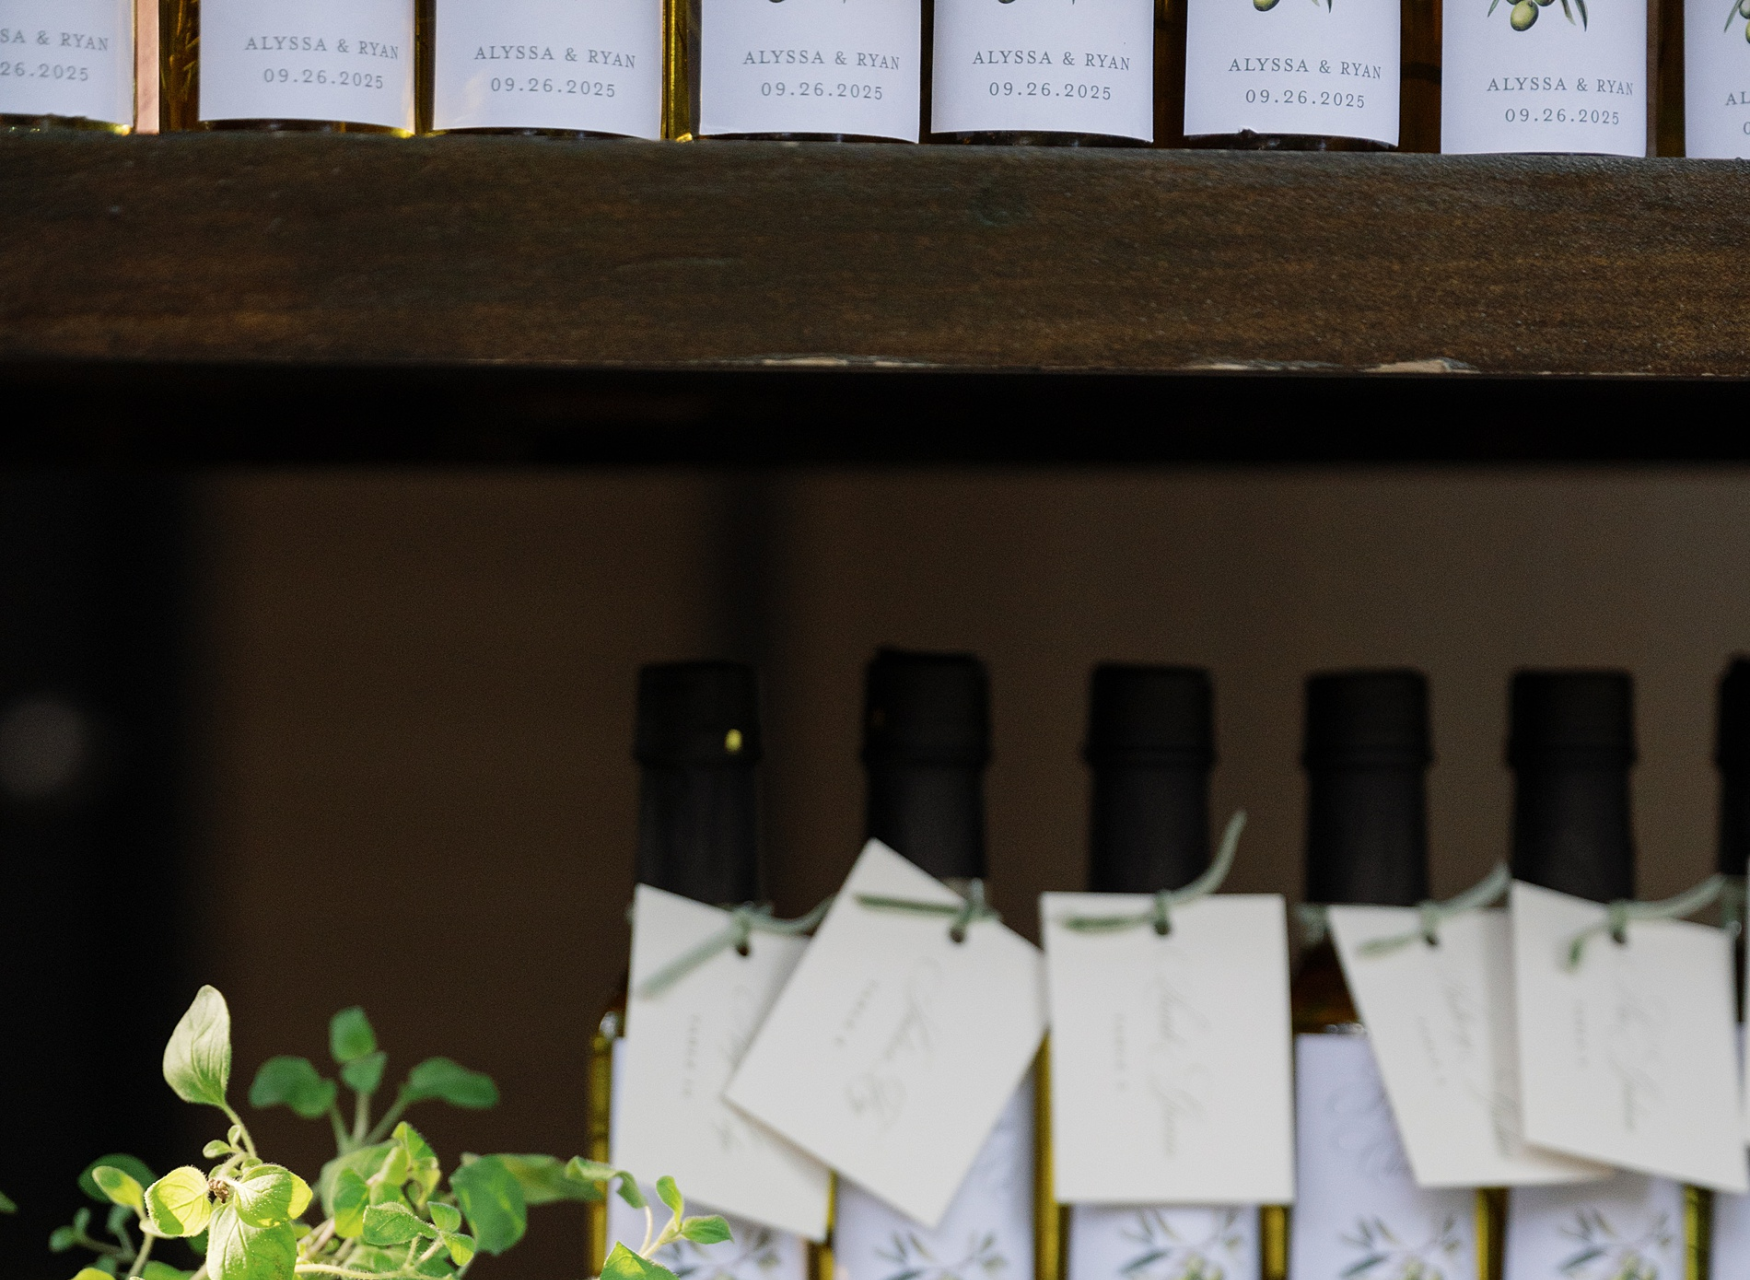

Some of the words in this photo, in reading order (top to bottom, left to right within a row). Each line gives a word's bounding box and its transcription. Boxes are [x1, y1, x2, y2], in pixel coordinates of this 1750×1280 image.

[36, 30, 49, 45] &
[60, 32, 108, 51] RYAN
[245, 36, 327, 51] ALYSSA
[337, 39, 349, 53] &
[358, 40, 398, 59] RYAN
[474, 46, 554, 60] ALYSSA
[565, 47, 577, 62] &
[588, 49, 635, 68] RYAN
[743, 50, 824, 65] ALYSSA
[834, 51, 847, 65] &
[857, 52, 899, 69] RYAN
[973, 50, 1052, 64] ALYSSA
[1062, 52, 1075, 66] &
[1085, 53, 1129, 70] RYAN
[263, 68, 383, 89] 09.26.2025
[1229, 58, 1309, 72] ALYSSA
[1319, 60, 1330, 74] &
[1340, 61, 1381, 79] RYAN
[490, 77, 615, 98] 09.26.2025
[761, 82, 882, 100] 09.26.2025
[989, 82, 1111, 100] 09.26.2025
[1487, 77, 1567, 91] ALYSSA
[1576, 78, 1587, 92] &
[1597, 79, 1633, 95] RYAN
[1245, 89, 1364, 108] 09.26.2025
[1505, 108, 1619, 125] 09.26.2025
